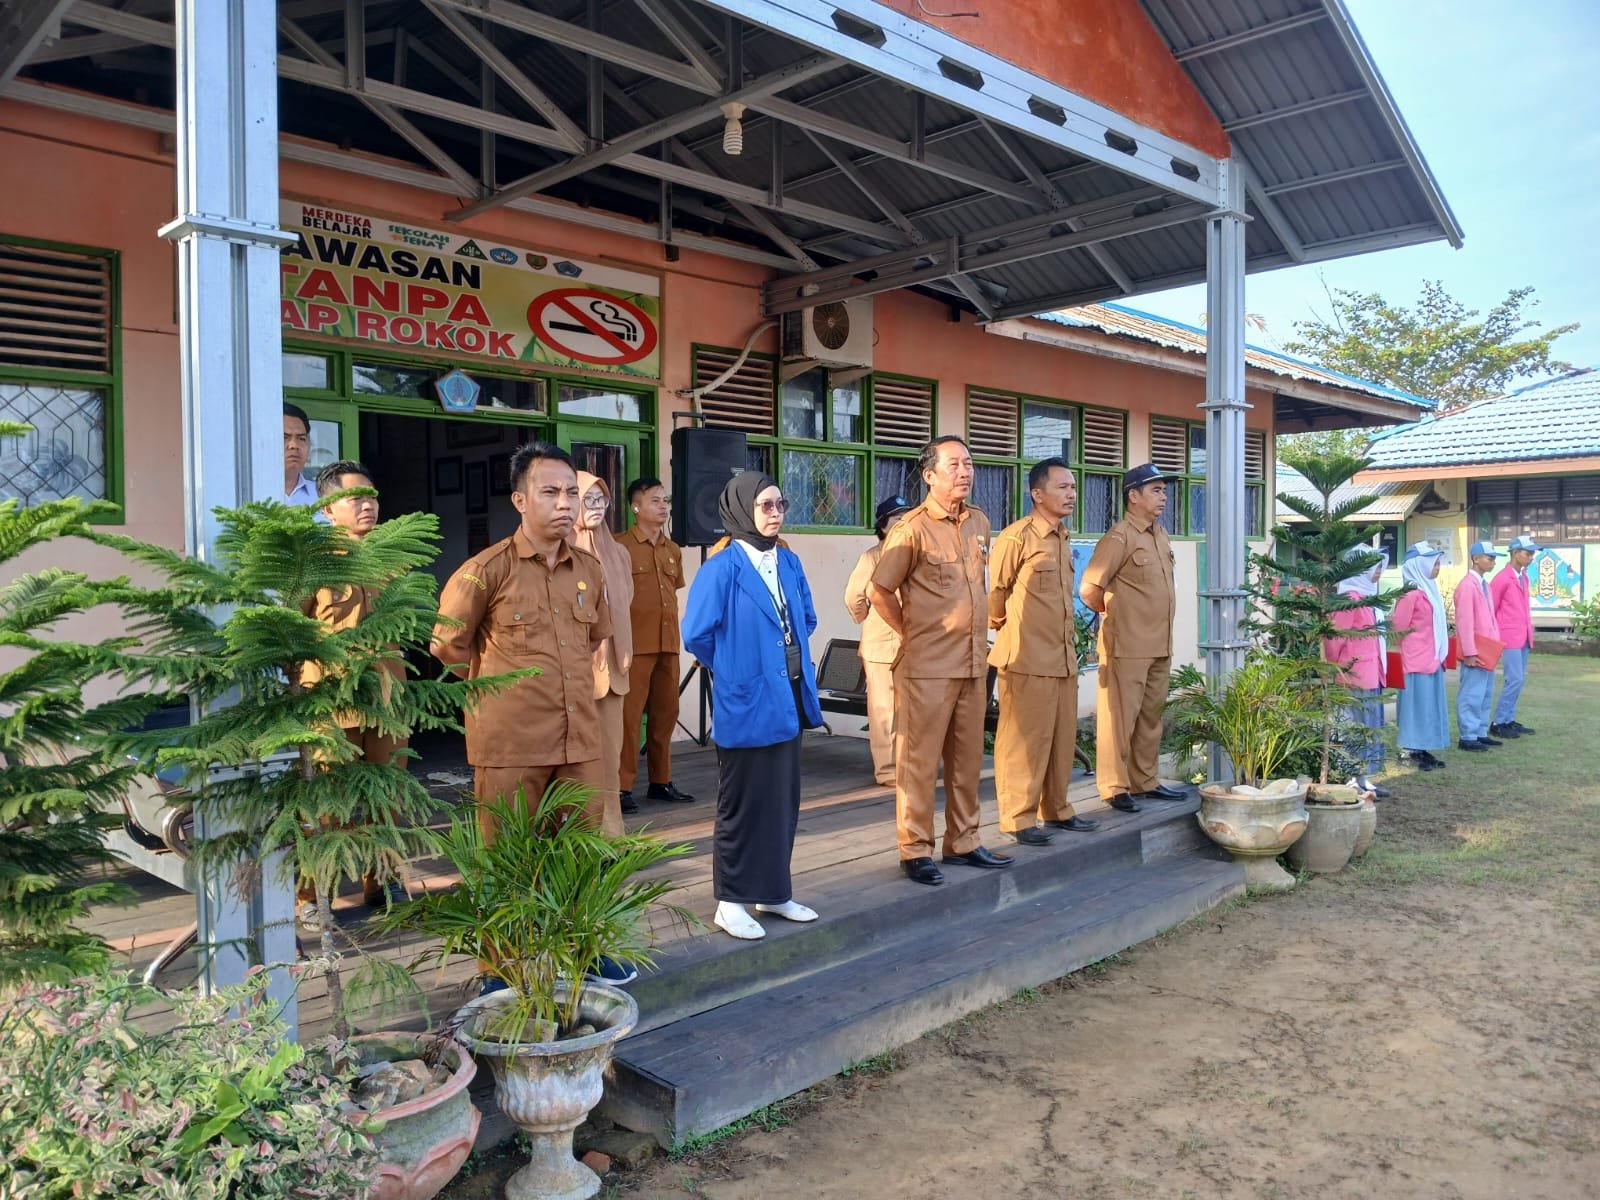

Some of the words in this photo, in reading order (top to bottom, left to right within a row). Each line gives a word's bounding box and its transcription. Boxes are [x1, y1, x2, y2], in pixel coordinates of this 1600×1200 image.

[302, 206, 372, 228] MERDEKA
[302, 216, 371, 239] BELAJAR
[388, 225, 450, 243] SEKOLAH
[280, 231, 480, 289] AWASAN
[281, 300, 340, 330] AP
[356, 311, 517, 358] ROKOK
